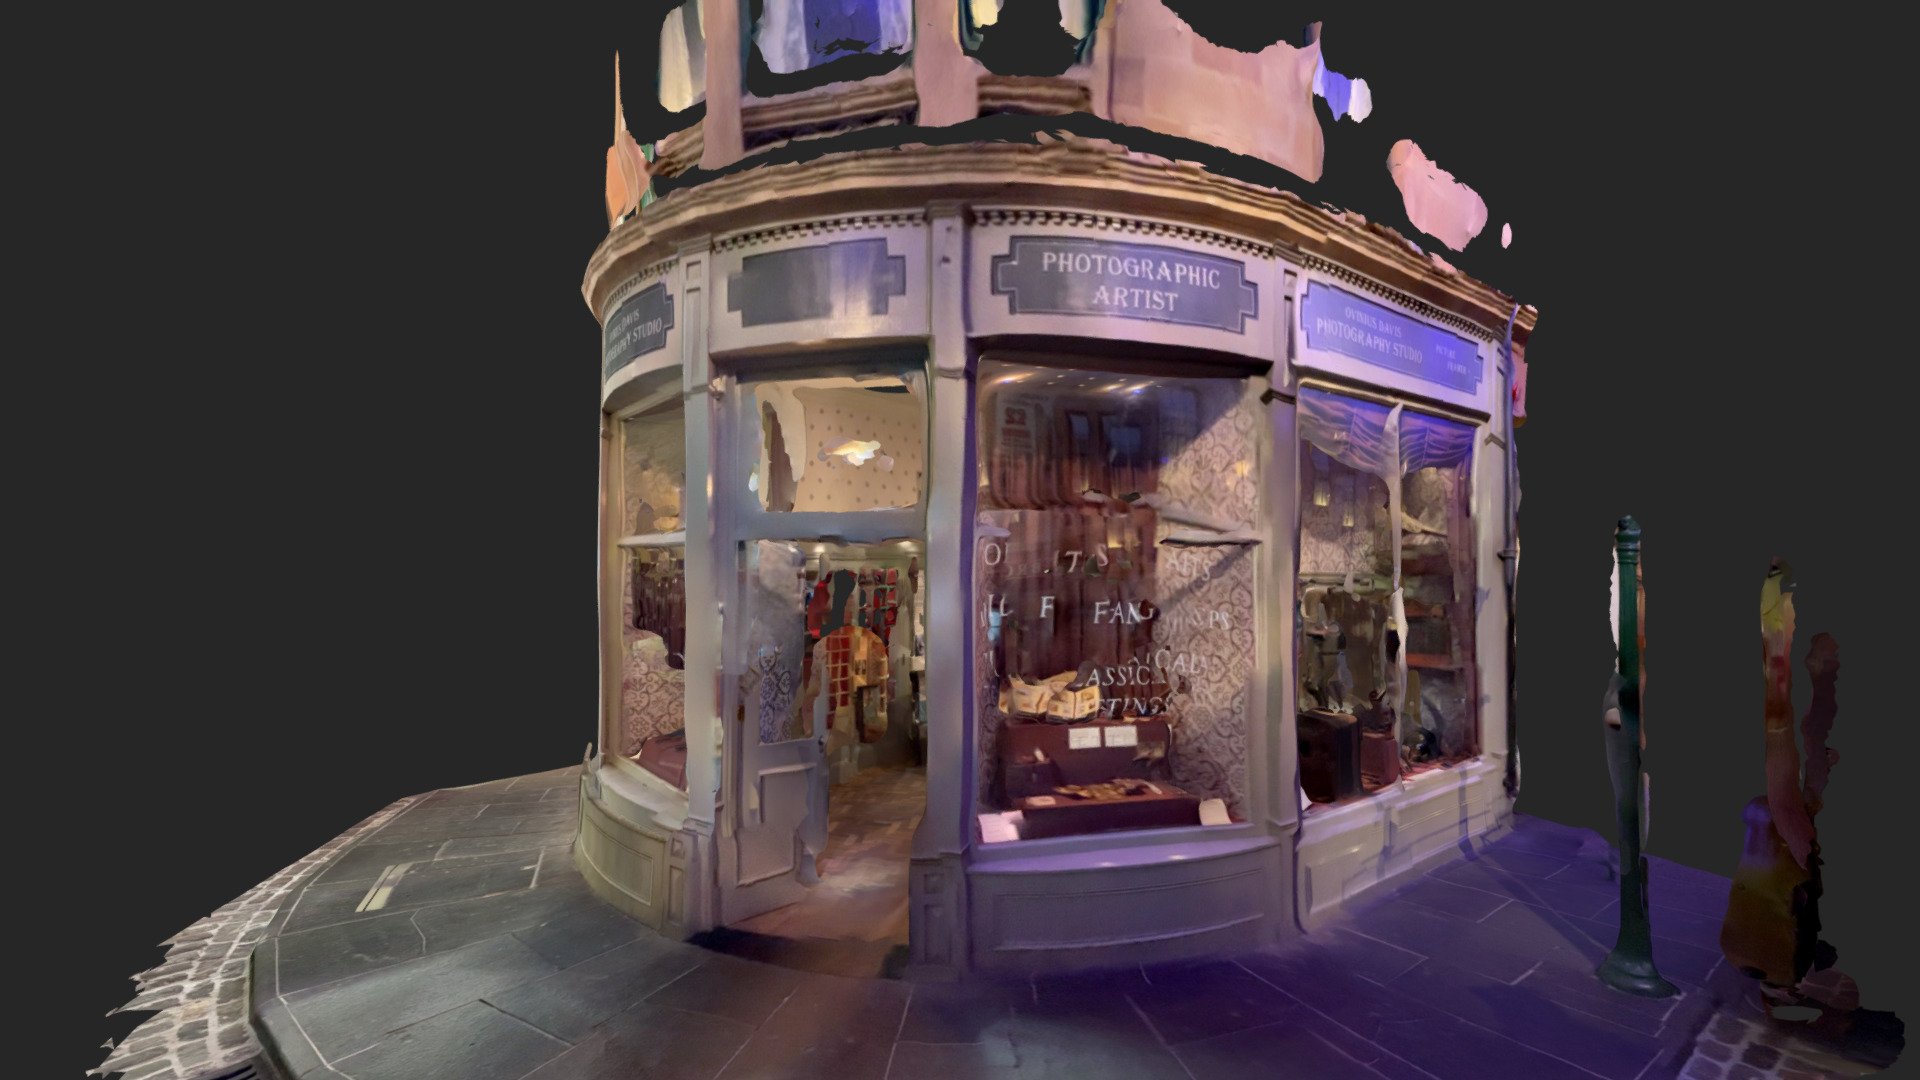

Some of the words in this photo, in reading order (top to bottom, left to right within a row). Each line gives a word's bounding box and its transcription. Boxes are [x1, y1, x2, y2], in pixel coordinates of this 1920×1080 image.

[1042, 252, 1220, 290] PHOTOGRAPHIC
[1093, 285, 1179, 312] ARTIST
[632, 317, 662, 344] STUDIO
[1316, 317, 1391, 354] PHOTOGRAPHY
[1393, 343, 1423, 365] STUDIO
[1379, 321, 1402, 338] DAVIS
